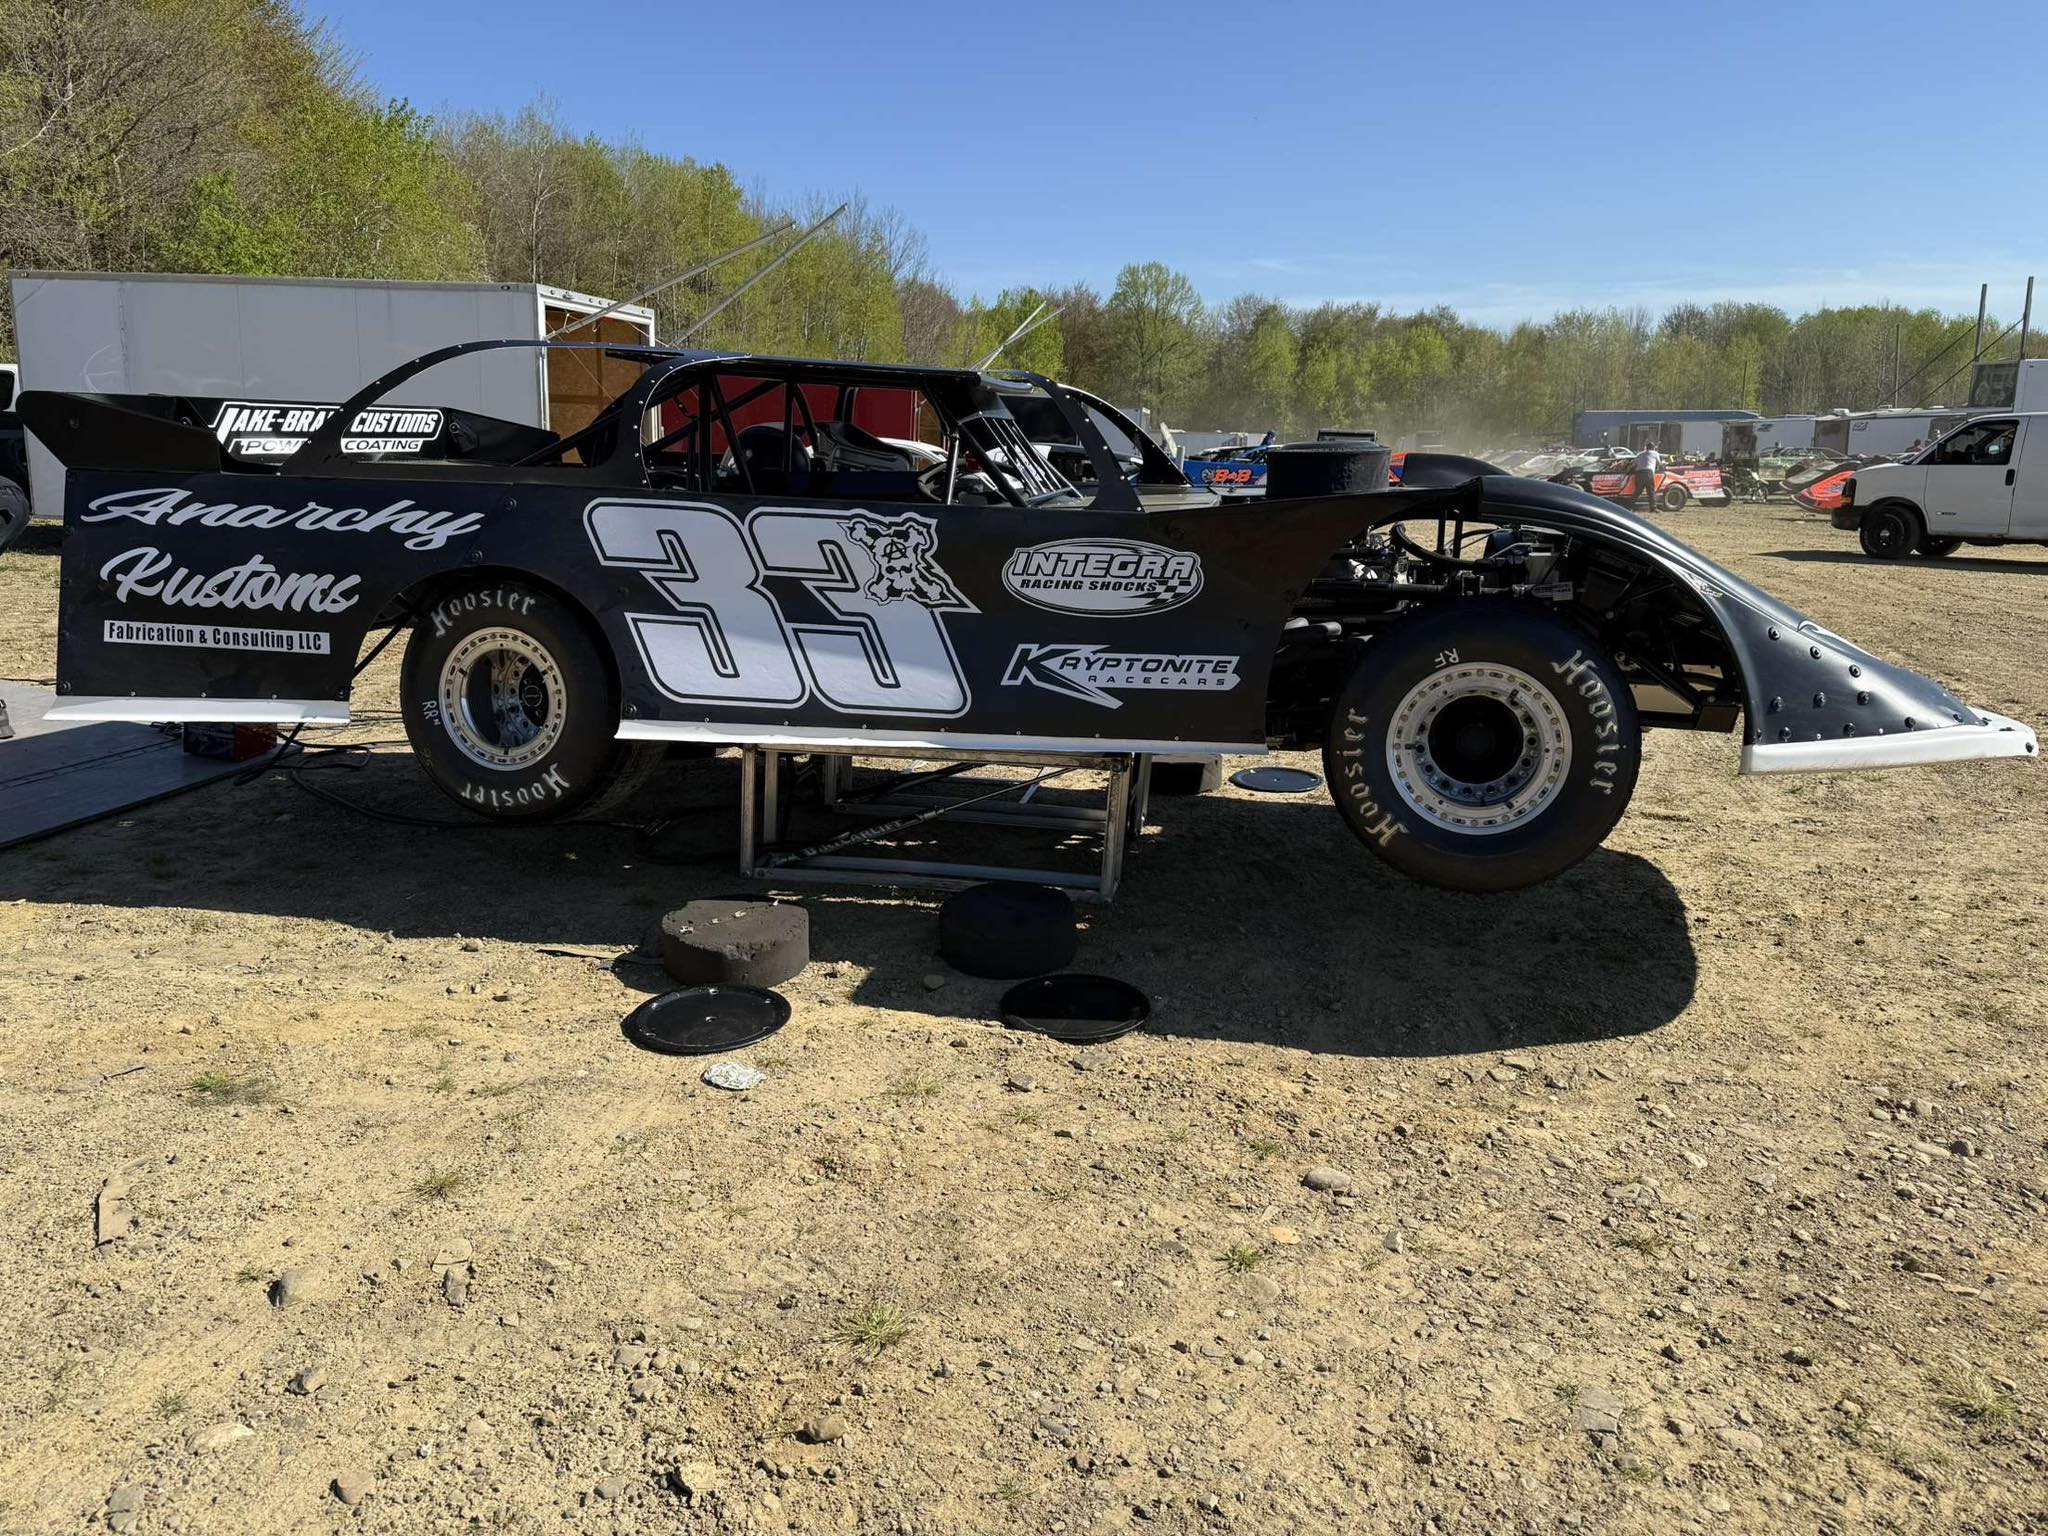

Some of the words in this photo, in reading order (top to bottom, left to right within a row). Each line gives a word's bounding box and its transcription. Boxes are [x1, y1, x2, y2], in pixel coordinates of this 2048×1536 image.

[217, 407, 335, 445] JAKE-BRA
[350, 412, 439, 433] CUSTOMS
[344, 439, 421, 451] COATING
[81, 488, 486, 551] Anarchy
[100, 547, 361, 613] Kustoms
[1012, 552, 1195, 579] INTEGRA
[1020, 578, 1083, 591] RACING
[1088, 580, 1157, 592] SHOCKS
[430, 584, 536, 637] Hoosier
[583, 498, 972, 719] 33
[108, 619, 194, 644] Fabrication
[199, 632, 209, 645] &
[213, 627, 294, 651] Consulting
[298, 633, 322, 651] LLC
[1434, 648, 1459, 669] RF
[1001, 644, 1234, 707] KRYPTONITE
[1088, 675, 1225, 686] RACECARS
[1551, 649, 1627, 795] Hoosier
[460, 762, 571, 812] Hoosier
[1336, 707, 1409, 847] Hoosier
